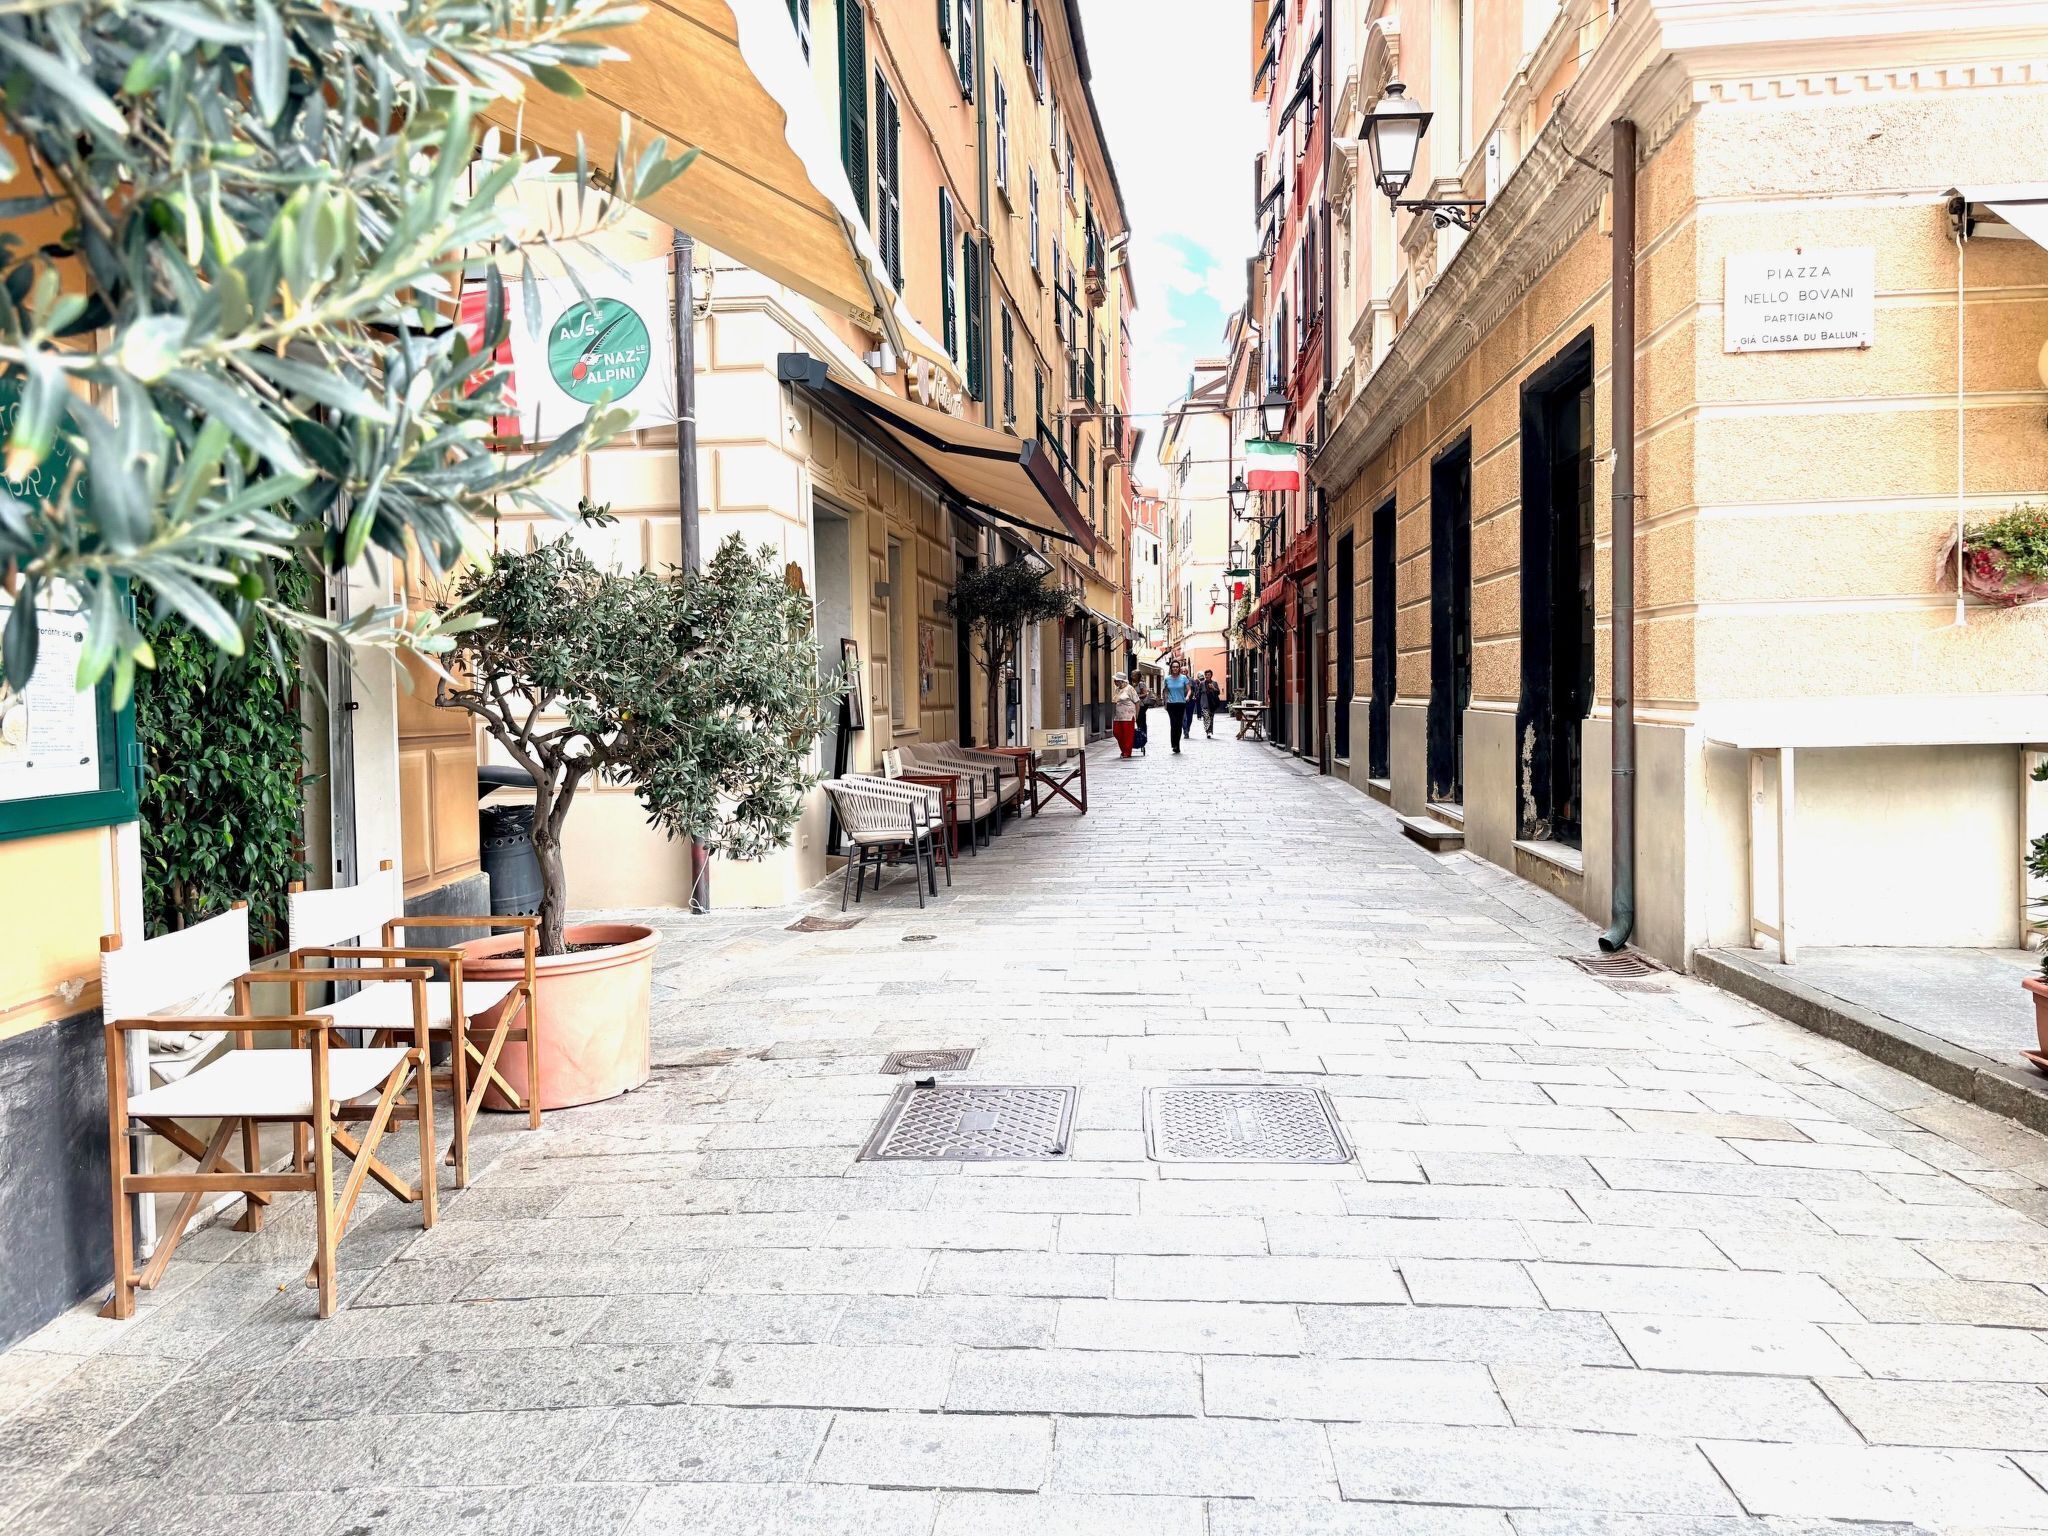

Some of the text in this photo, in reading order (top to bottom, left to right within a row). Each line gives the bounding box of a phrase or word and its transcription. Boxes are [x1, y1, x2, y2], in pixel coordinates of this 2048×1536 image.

[1767, 266, 1832, 280] PIAZZA
[1744, 287, 1854, 304] NELLO BOVANI
[1764, 311, 1834, 323] PARTIGIANO
[1803, 333, 1817, 341] DU
[586, 366, 635, 384] ALPINI
